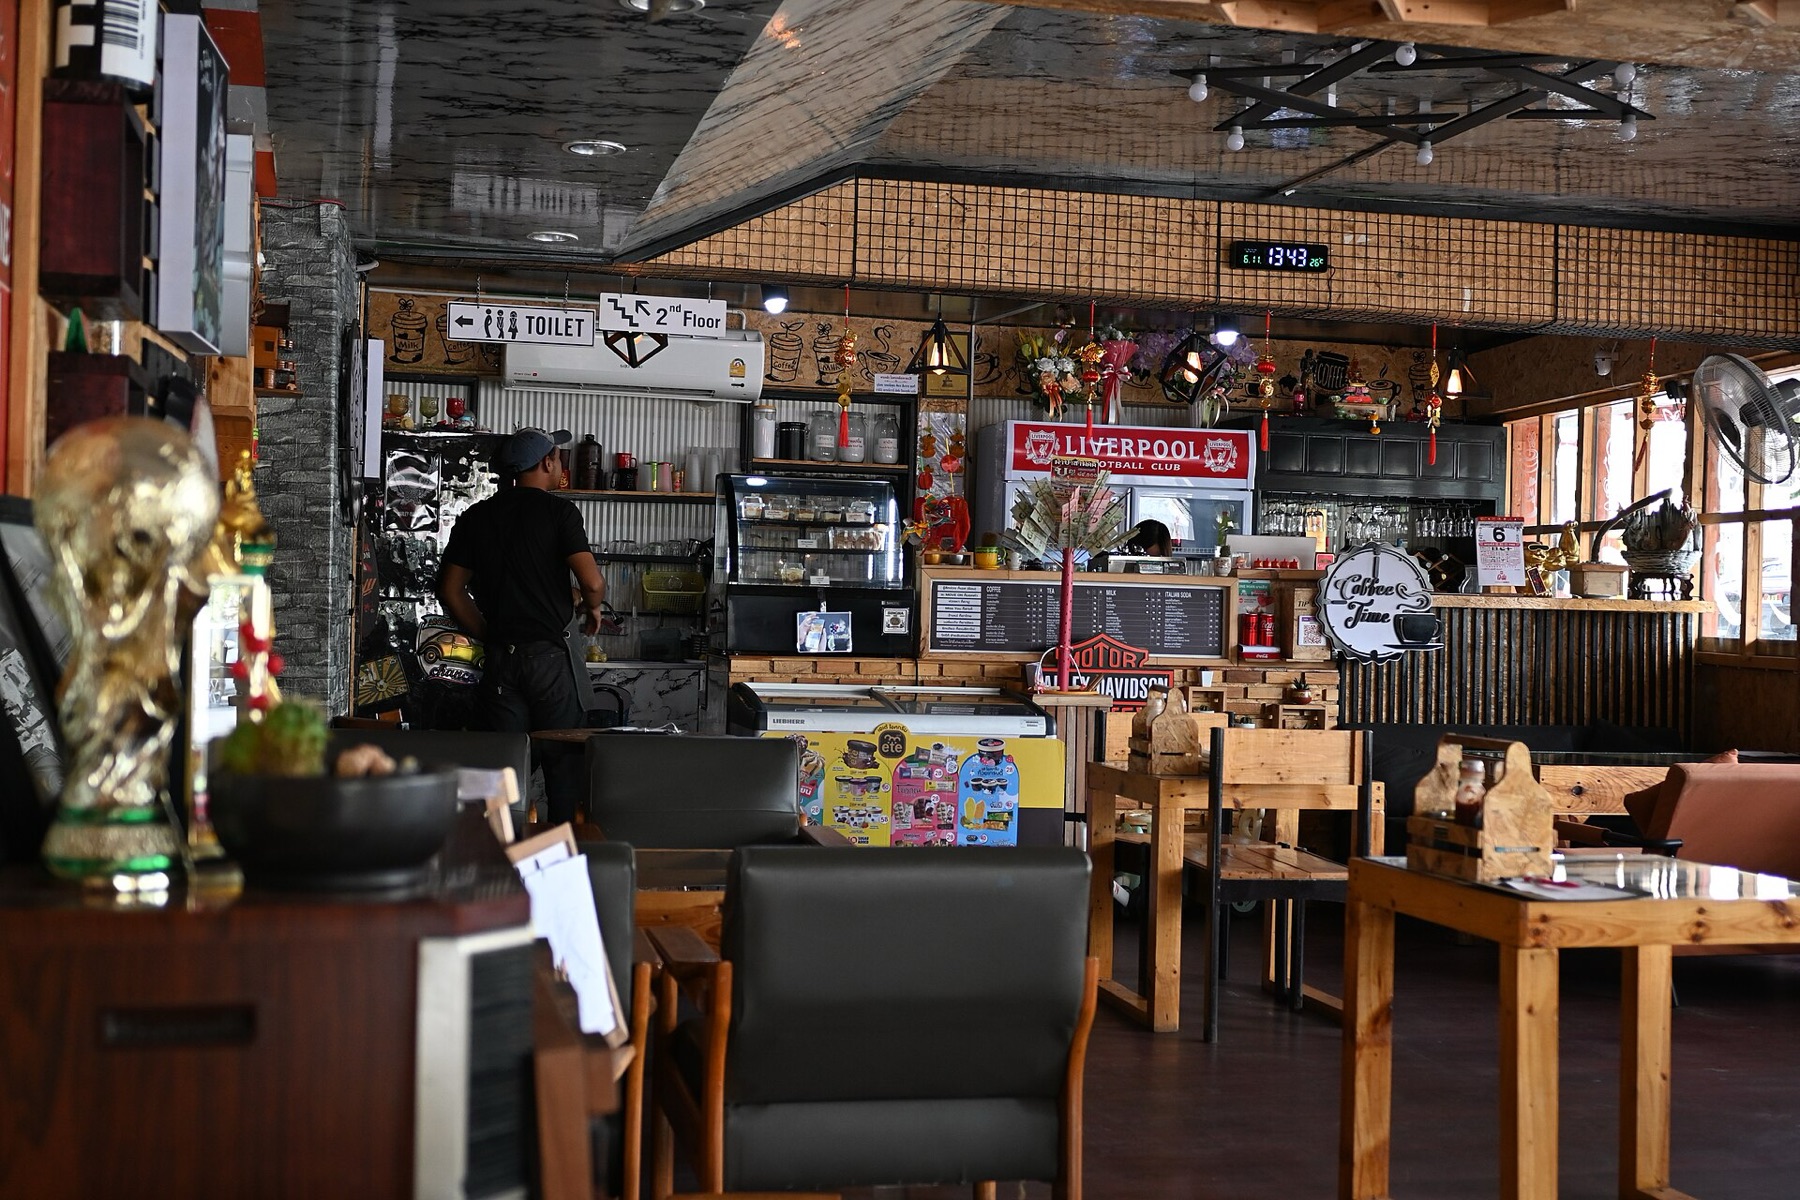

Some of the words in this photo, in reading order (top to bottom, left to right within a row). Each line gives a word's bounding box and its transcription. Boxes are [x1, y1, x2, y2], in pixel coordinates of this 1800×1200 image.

[525, 315, 585, 338] TOILET
[655, 303, 682, 326] 2nd
[683, 310, 721, 329] Floor
[398, 341, 419, 350] Milk
[774, 361, 796, 370] Coffee
[1065, 435, 1201, 460] LIVERPOOL
[1098, 459, 1145, 471] OTBALL
[1151, 462, 1182, 471] CLUB
[1492, 527, 1506, 543] 6
[1334, 573, 1395, 600] Coffee
[1344, 598, 1391, 629] Time
[1068, 641, 1136, 668] MOTOR
